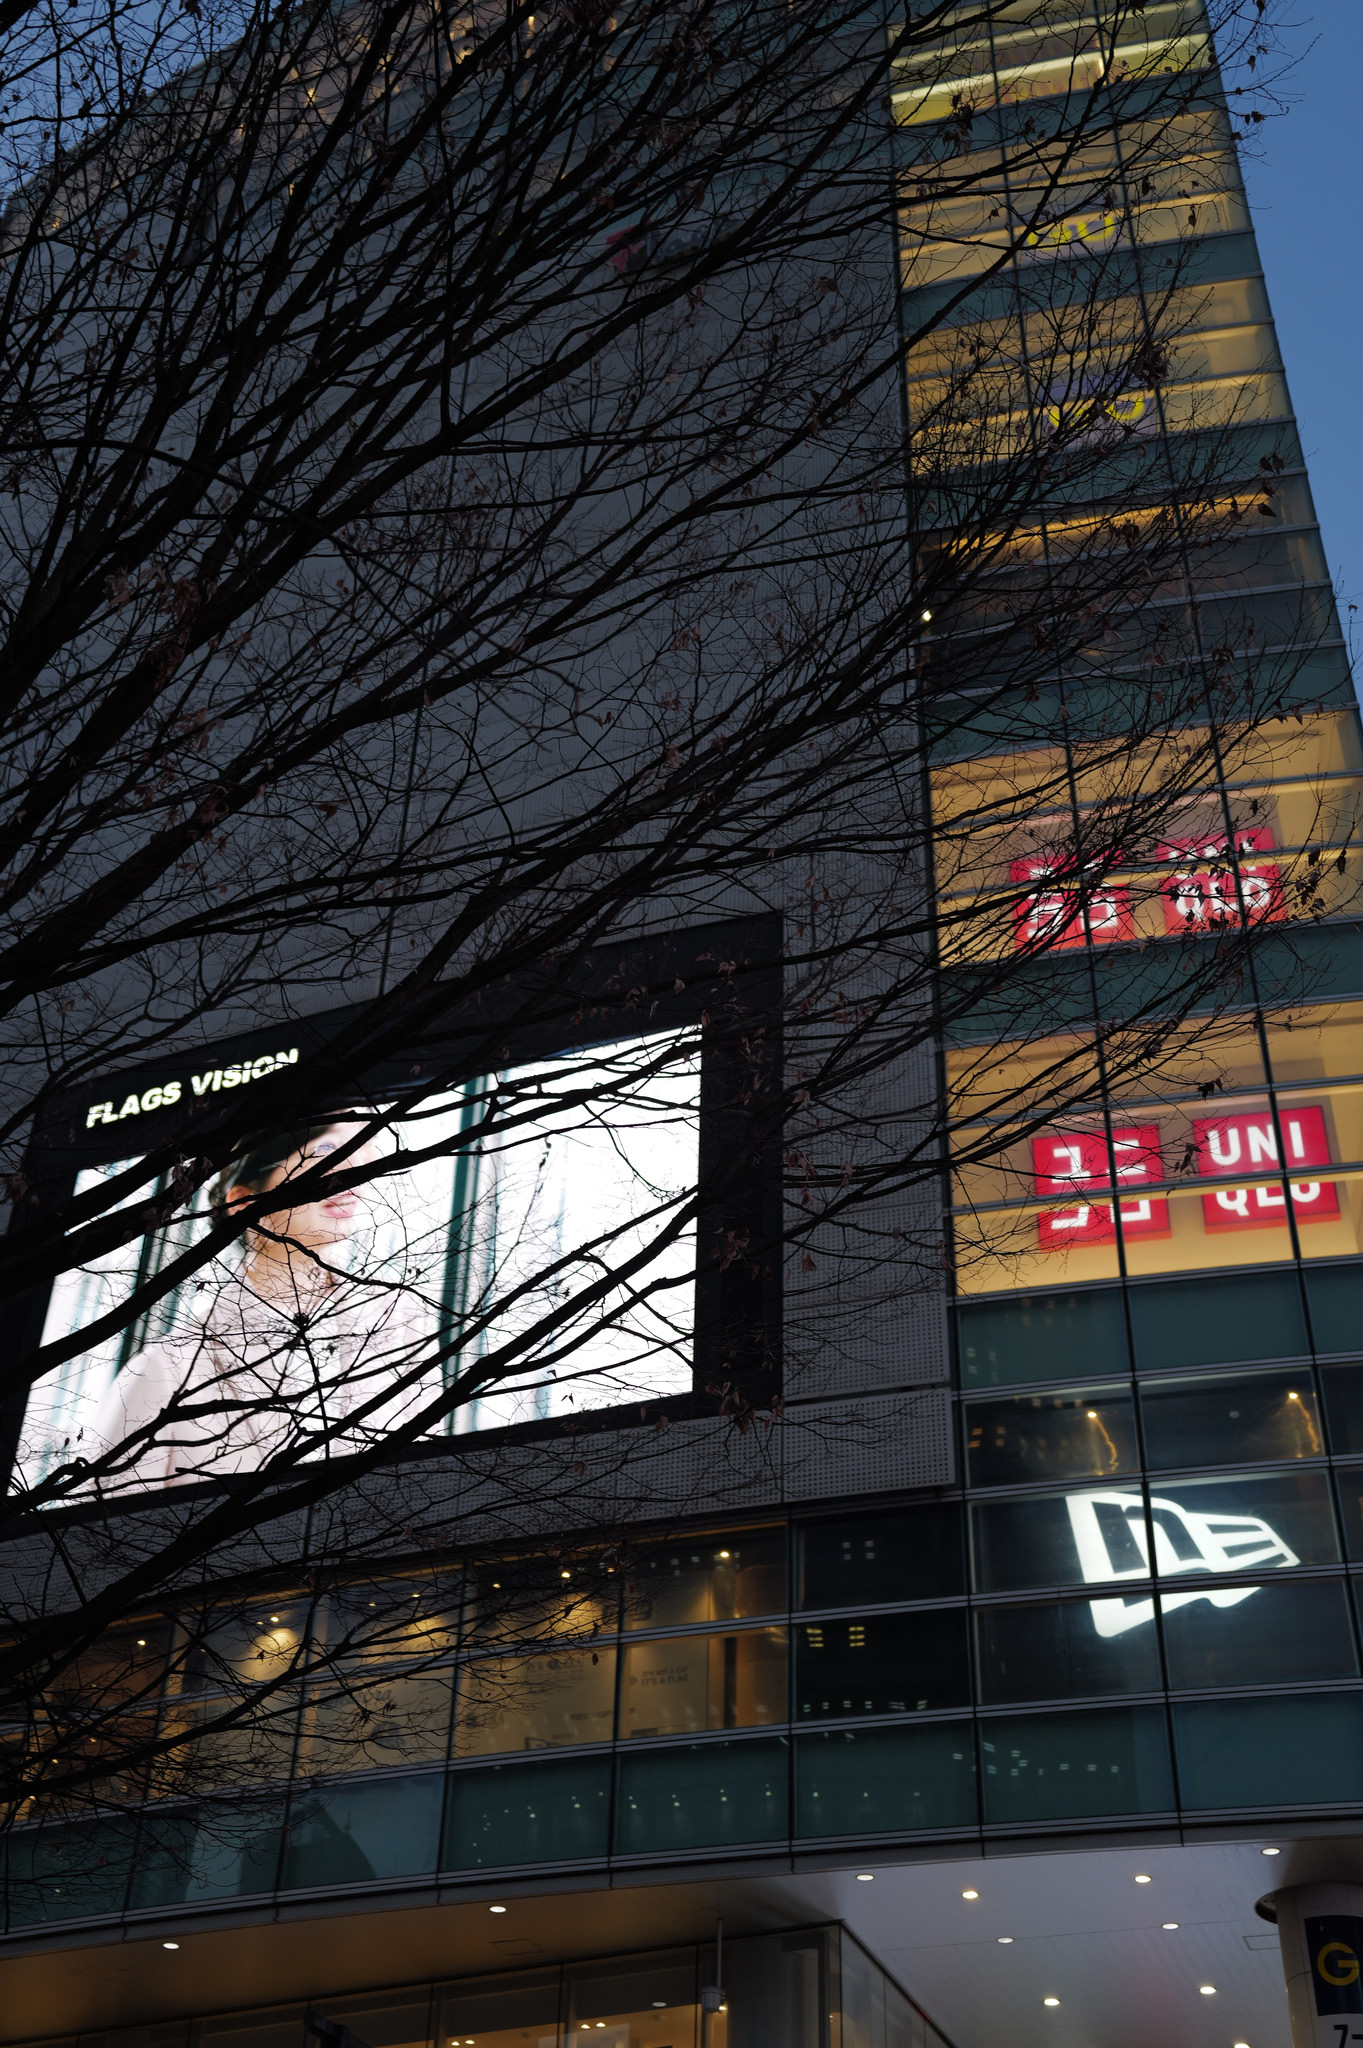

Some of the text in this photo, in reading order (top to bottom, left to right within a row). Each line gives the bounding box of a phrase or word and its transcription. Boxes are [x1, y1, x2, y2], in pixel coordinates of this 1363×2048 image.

[85, 1048, 300, 1130] FLAGS VISION
[1051, 1139, 1147, 1184] ユニ
[1207, 1120, 1306, 1166] UNI
